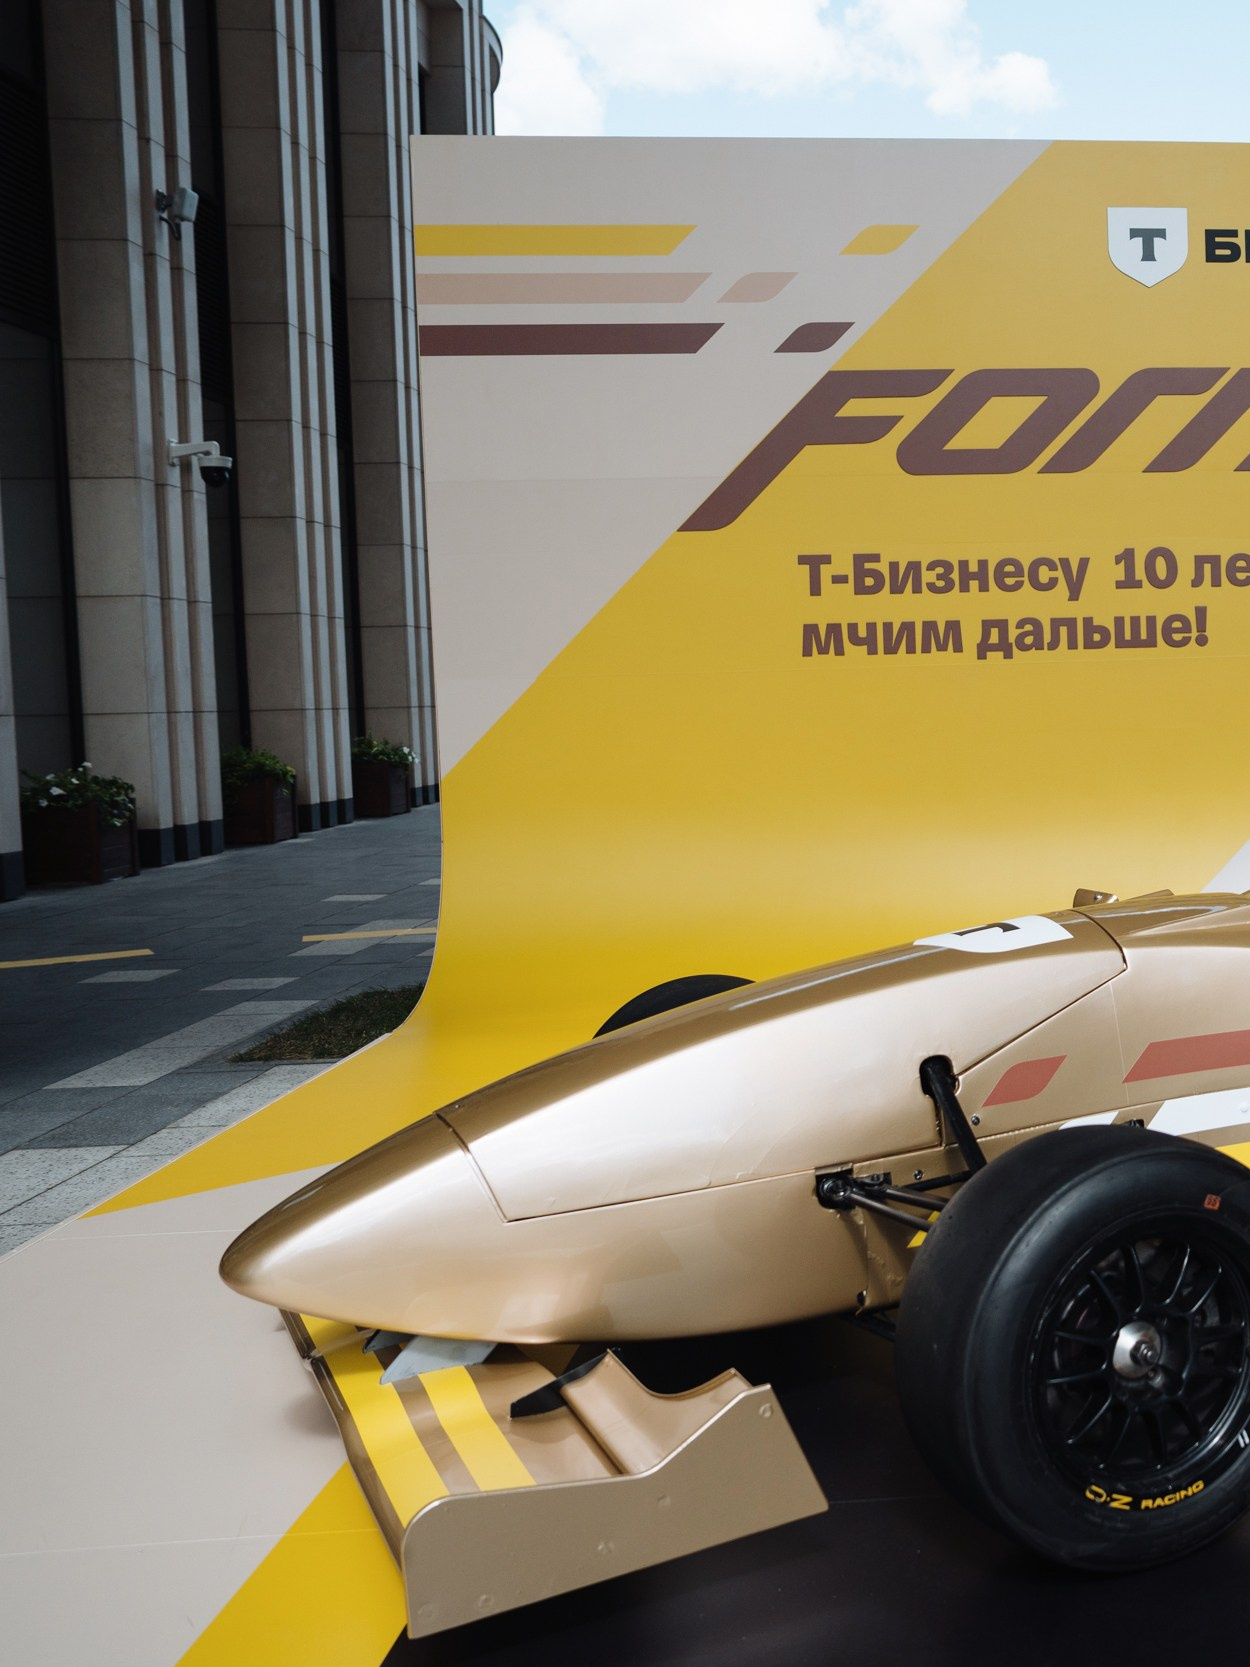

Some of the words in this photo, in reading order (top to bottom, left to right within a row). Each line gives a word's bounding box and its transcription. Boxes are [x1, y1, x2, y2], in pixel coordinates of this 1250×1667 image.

[797, 552, 1091, 602] Т-Бизнесу
[1113, 546, 1179, 590] 10
[800, 616, 964, 659] мчим
[976, 603, 1210, 661] дальше!
[1140, 1480, 1205, 1510] RACING
